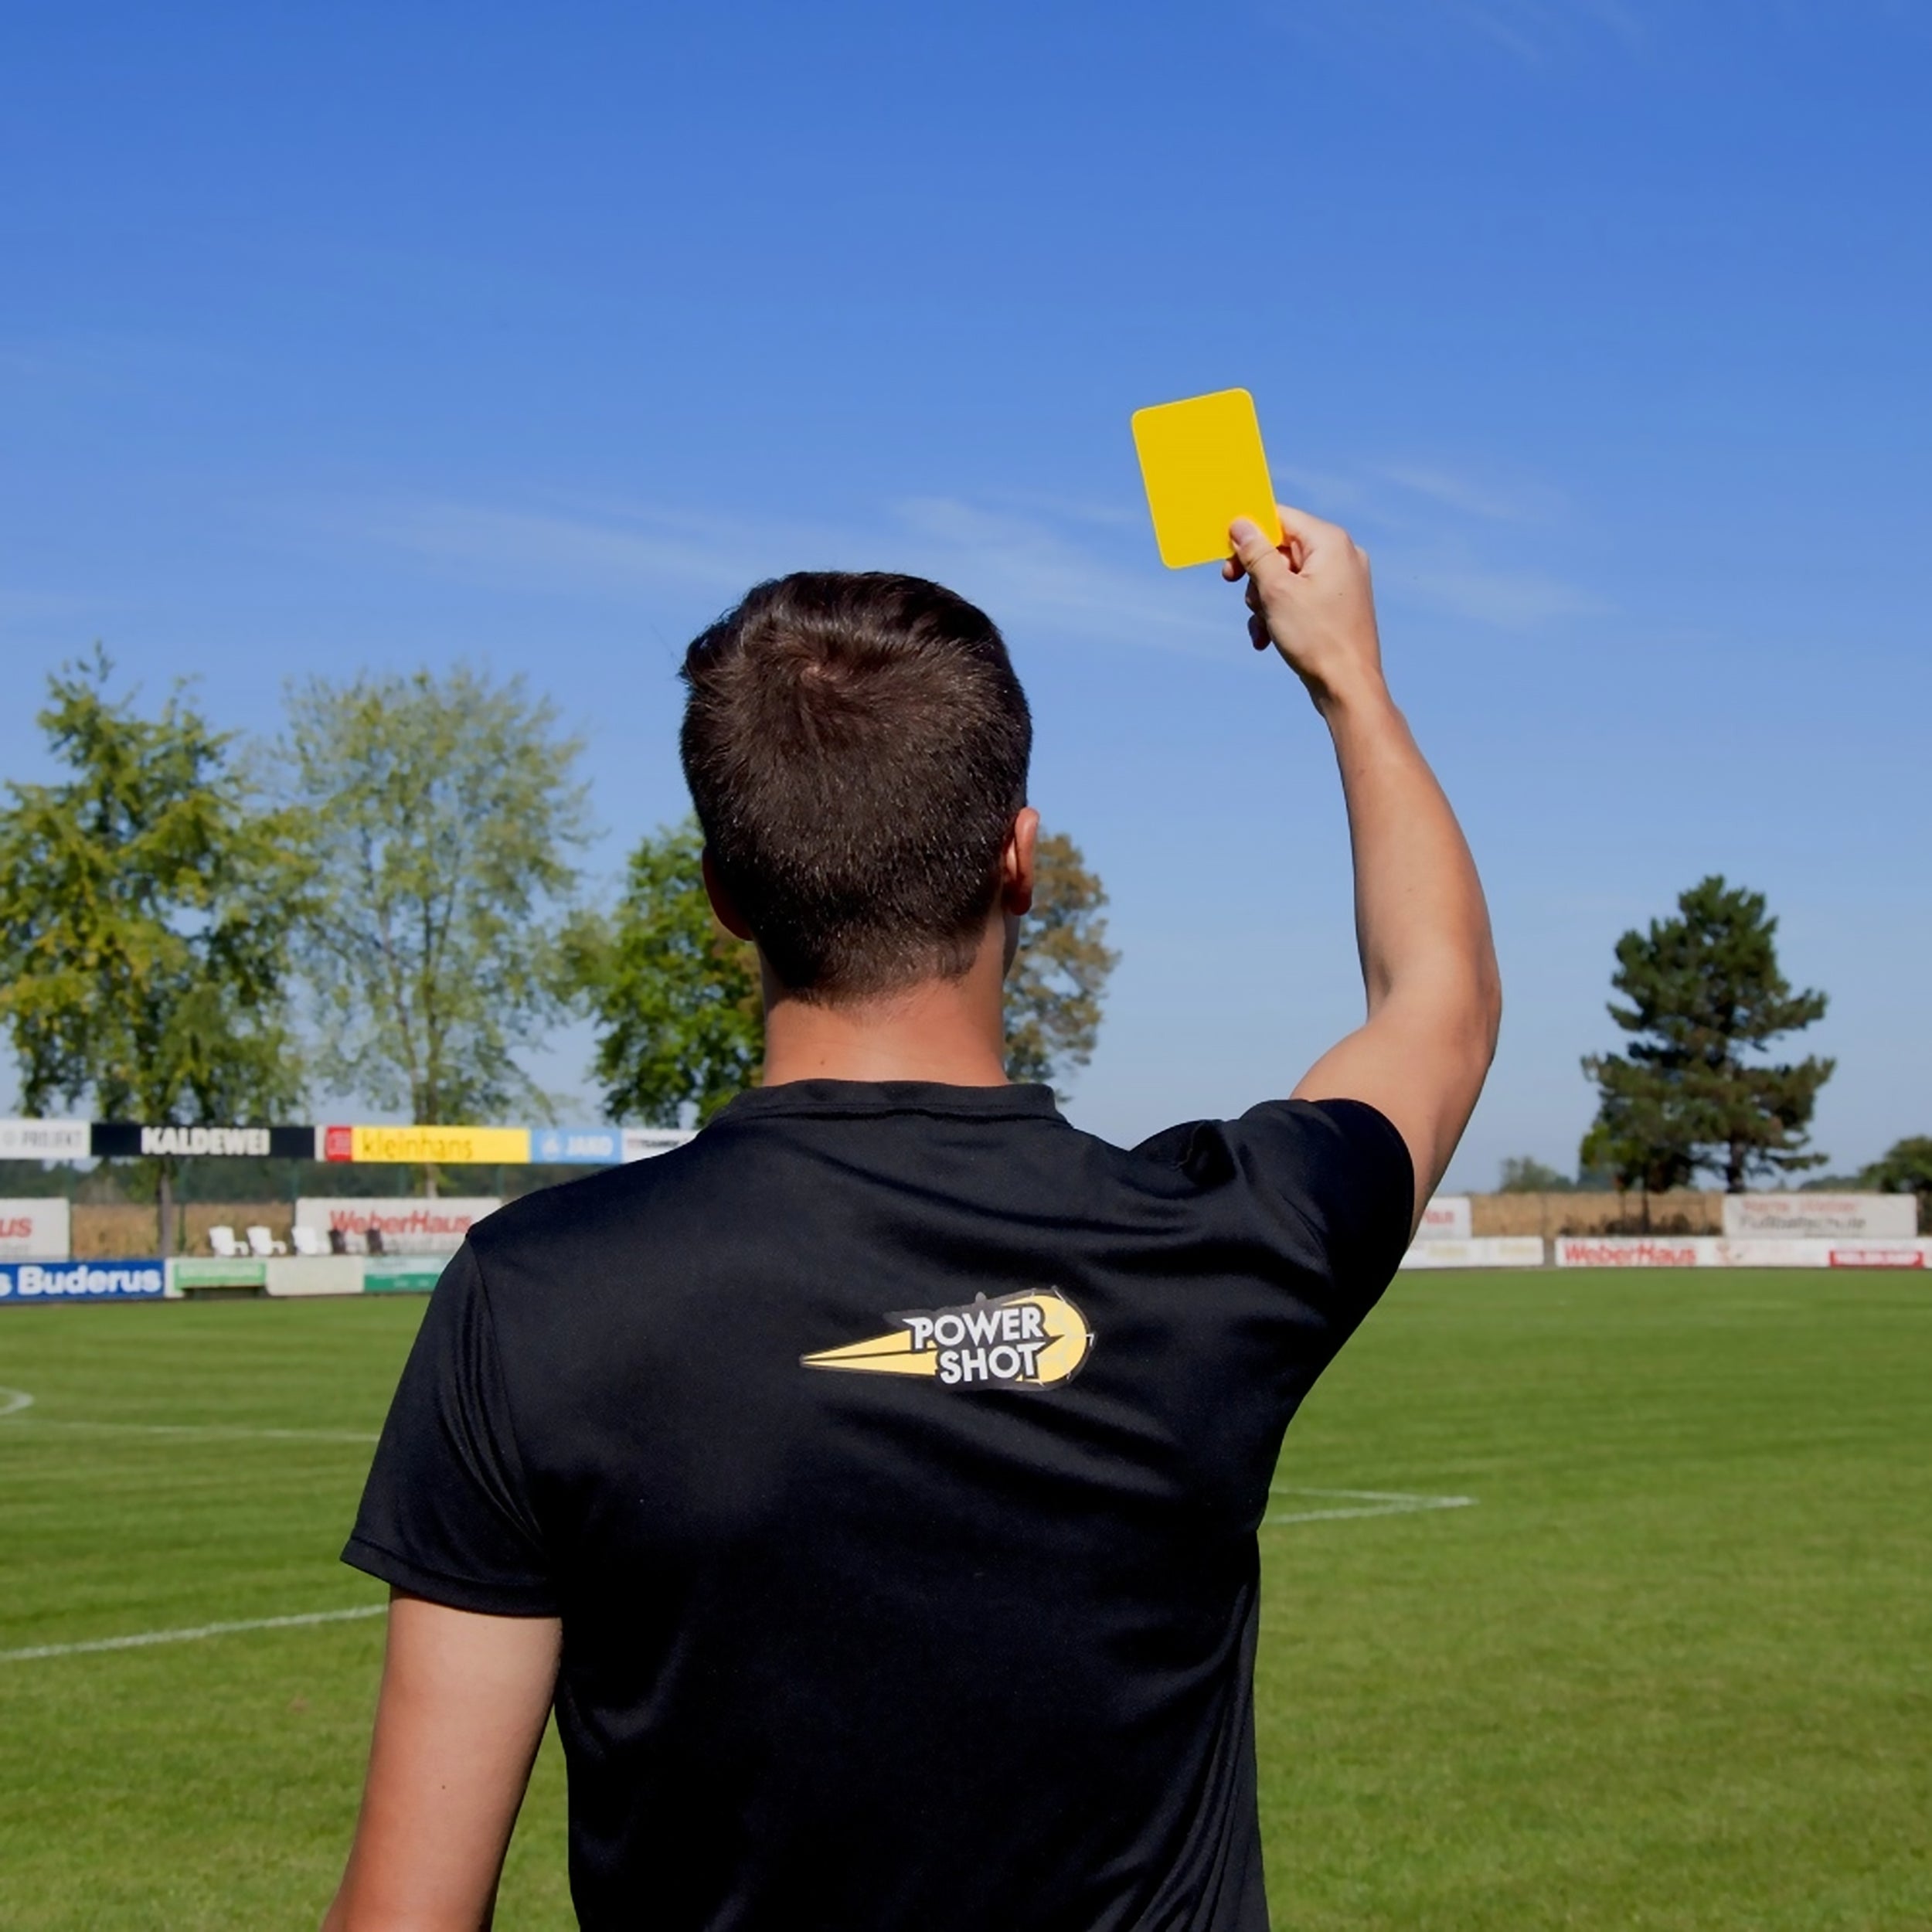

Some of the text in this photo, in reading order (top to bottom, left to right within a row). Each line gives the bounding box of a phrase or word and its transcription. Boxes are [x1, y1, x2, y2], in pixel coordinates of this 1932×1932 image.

[141, 1126, 270, 1156] KALDEWEI
[361, 1128, 474, 1159] kleinhans
[329, 1209, 473, 1234] WeberHaus
[17, 1264, 162, 1295] Buderus
[902, 1306, 1044, 1350] POWER
[939, 1342, 1046, 1385] SHOT
